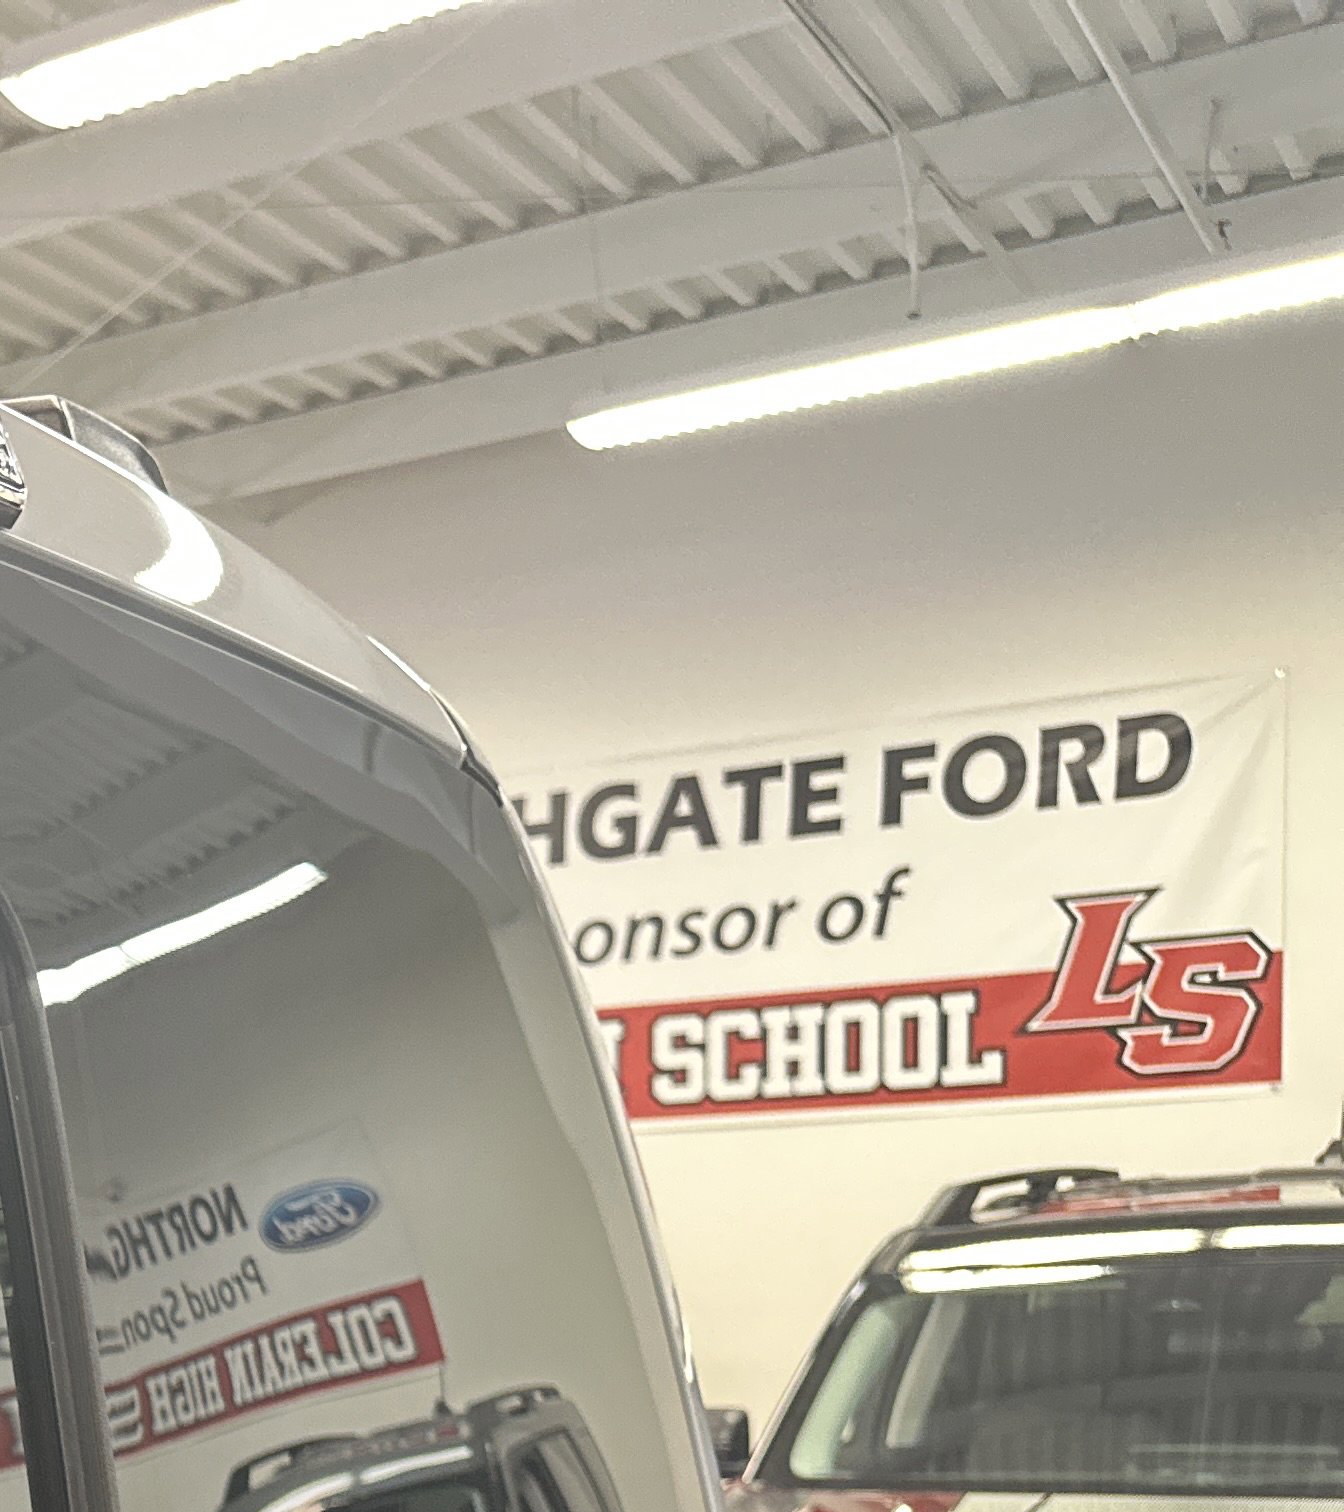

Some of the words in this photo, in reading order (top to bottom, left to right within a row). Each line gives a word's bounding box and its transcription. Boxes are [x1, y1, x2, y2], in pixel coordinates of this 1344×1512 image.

[880, 711, 1193, 828] FORD
[573, 898, 799, 965] onsor
[817, 866, 910, 944] of
[1017, 886, 1272, 1080] LS
[651, 990, 1005, 1106] SCHOOL
